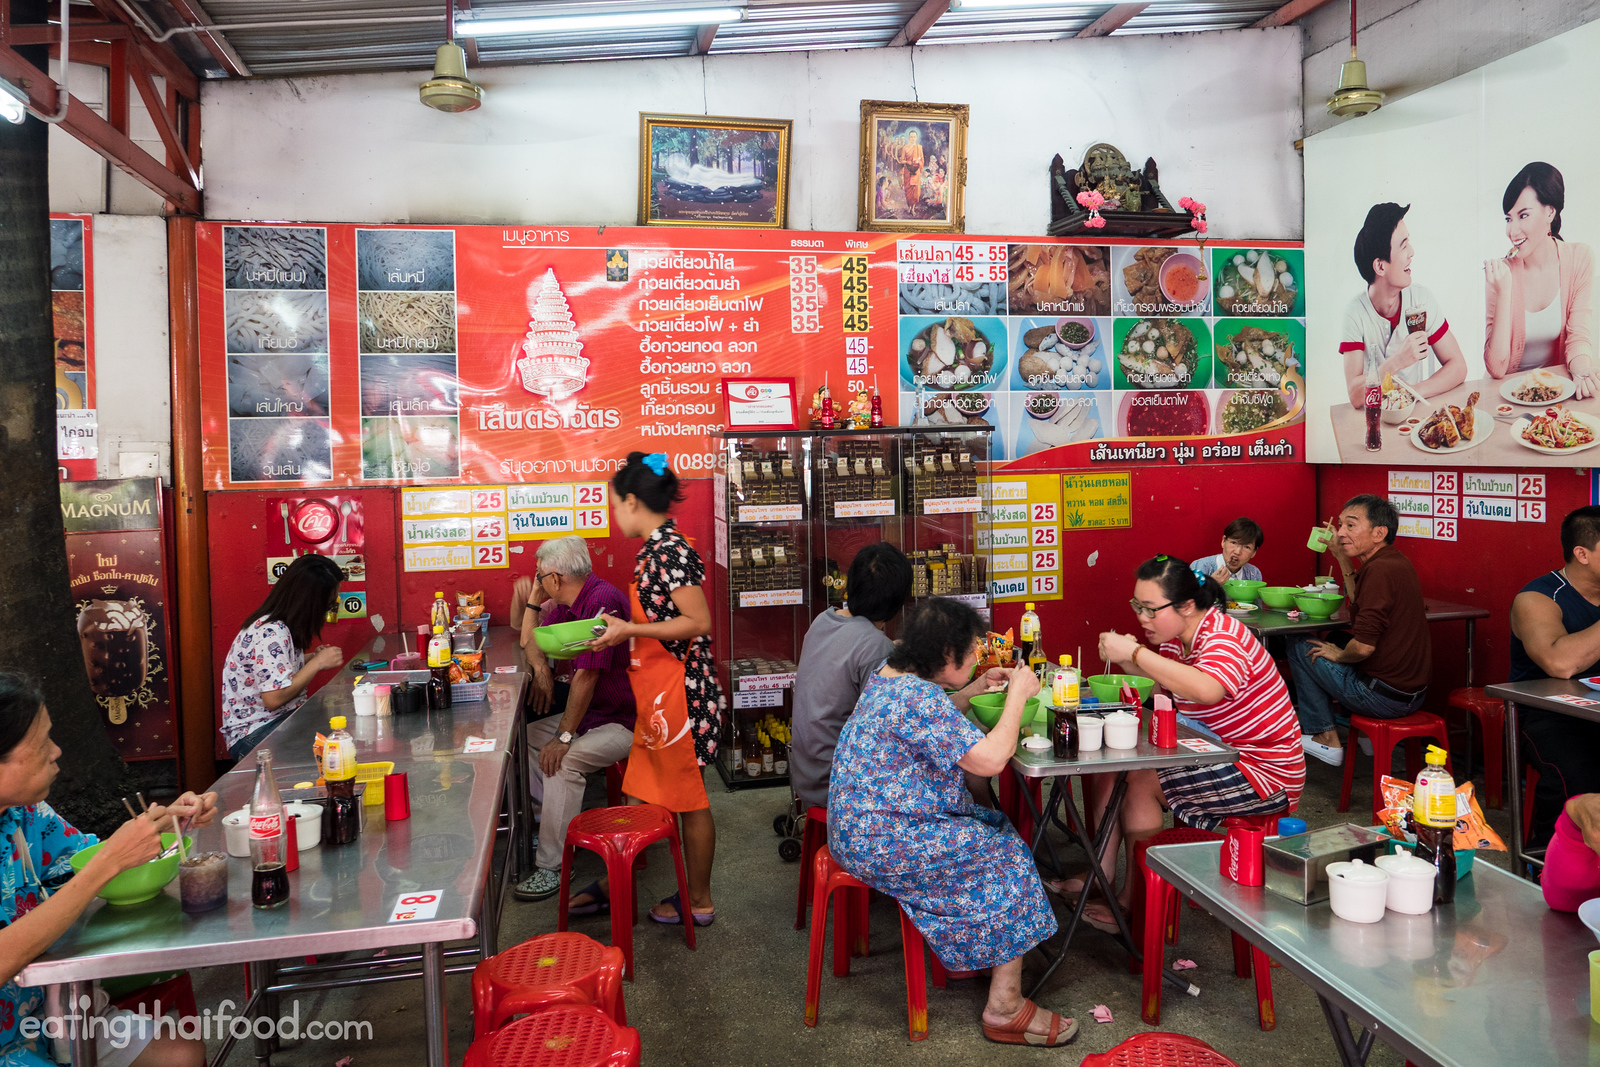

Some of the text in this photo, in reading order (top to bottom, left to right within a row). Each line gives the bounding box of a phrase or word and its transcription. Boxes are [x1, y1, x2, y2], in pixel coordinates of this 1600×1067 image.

[502, 230, 570, 246] เมนูอาหาร
[790, 239, 824, 248] ธรรมดา
[844, 239, 868, 249] พิเศษ
[899, 244, 952, 261] เส้นปลา
[955, 245, 974, 261] 45
[988, 245, 1007, 261] 55
[956, 266, 974, 281] 45
[989, 266, 1008, 281] 55
[638, 292, 764, 312] ก๋วยเตี๋ยวเย็นตาโฟ
[934, 297, 970, 311] เส้นปลา
[728, 322, 738, 332] +
[744, 316, 760, 332] ยำ
[728, 340, 758, 353] ลวก
[722, 360, 752, 374] ลวก
[640, 378, 710, 398] ลูกชิ้นรวม
[256, 397, 304, 413] เส้นใหญ่
[60, 426, 94, 438] ไก่อบ
[1090, 438, 1292, 464] เส้นเหนียว นุ่ม อร่อย เต็มคำ
[262, 461, 301, 478] วุ้นเส้น
[1436, 474, 1454, 490] 25
[1466, 476, 1513, 493] น้ำใบบัวบก
[1521, 478, 1543, 494] 25
[476, 492, 501, 508] 25
[511, 490, 569, 505] น้ำใบบัวบก
[579, 487, 602, 504] 25
[60, 499, 152, 519] MAGNUM
[1034, 504, 1054, 520] 25
[1436, 498, 1454, 514] 25
[1521, 503, 1542, 520] 15
[579, 510, 602, 526] 15
[477, 522, 502, 538] 25
[1035, 529, 1055, 544] 25
[1436, 522, 1454, 538] 25
[96, 552, 118, 567] ใหม่
[408, 550, 468, 567] น้ำกระเจี๊ยบ
[478, 547, 503, 564] 25
[1036, 552, 1055, 568] 25
[1035, 578, 1054, 592] 15
[347, 601, 360, 610] 10
[1228, 834, 1239, 881] Coca-Cola
[400, 894, 437, 906] 8
